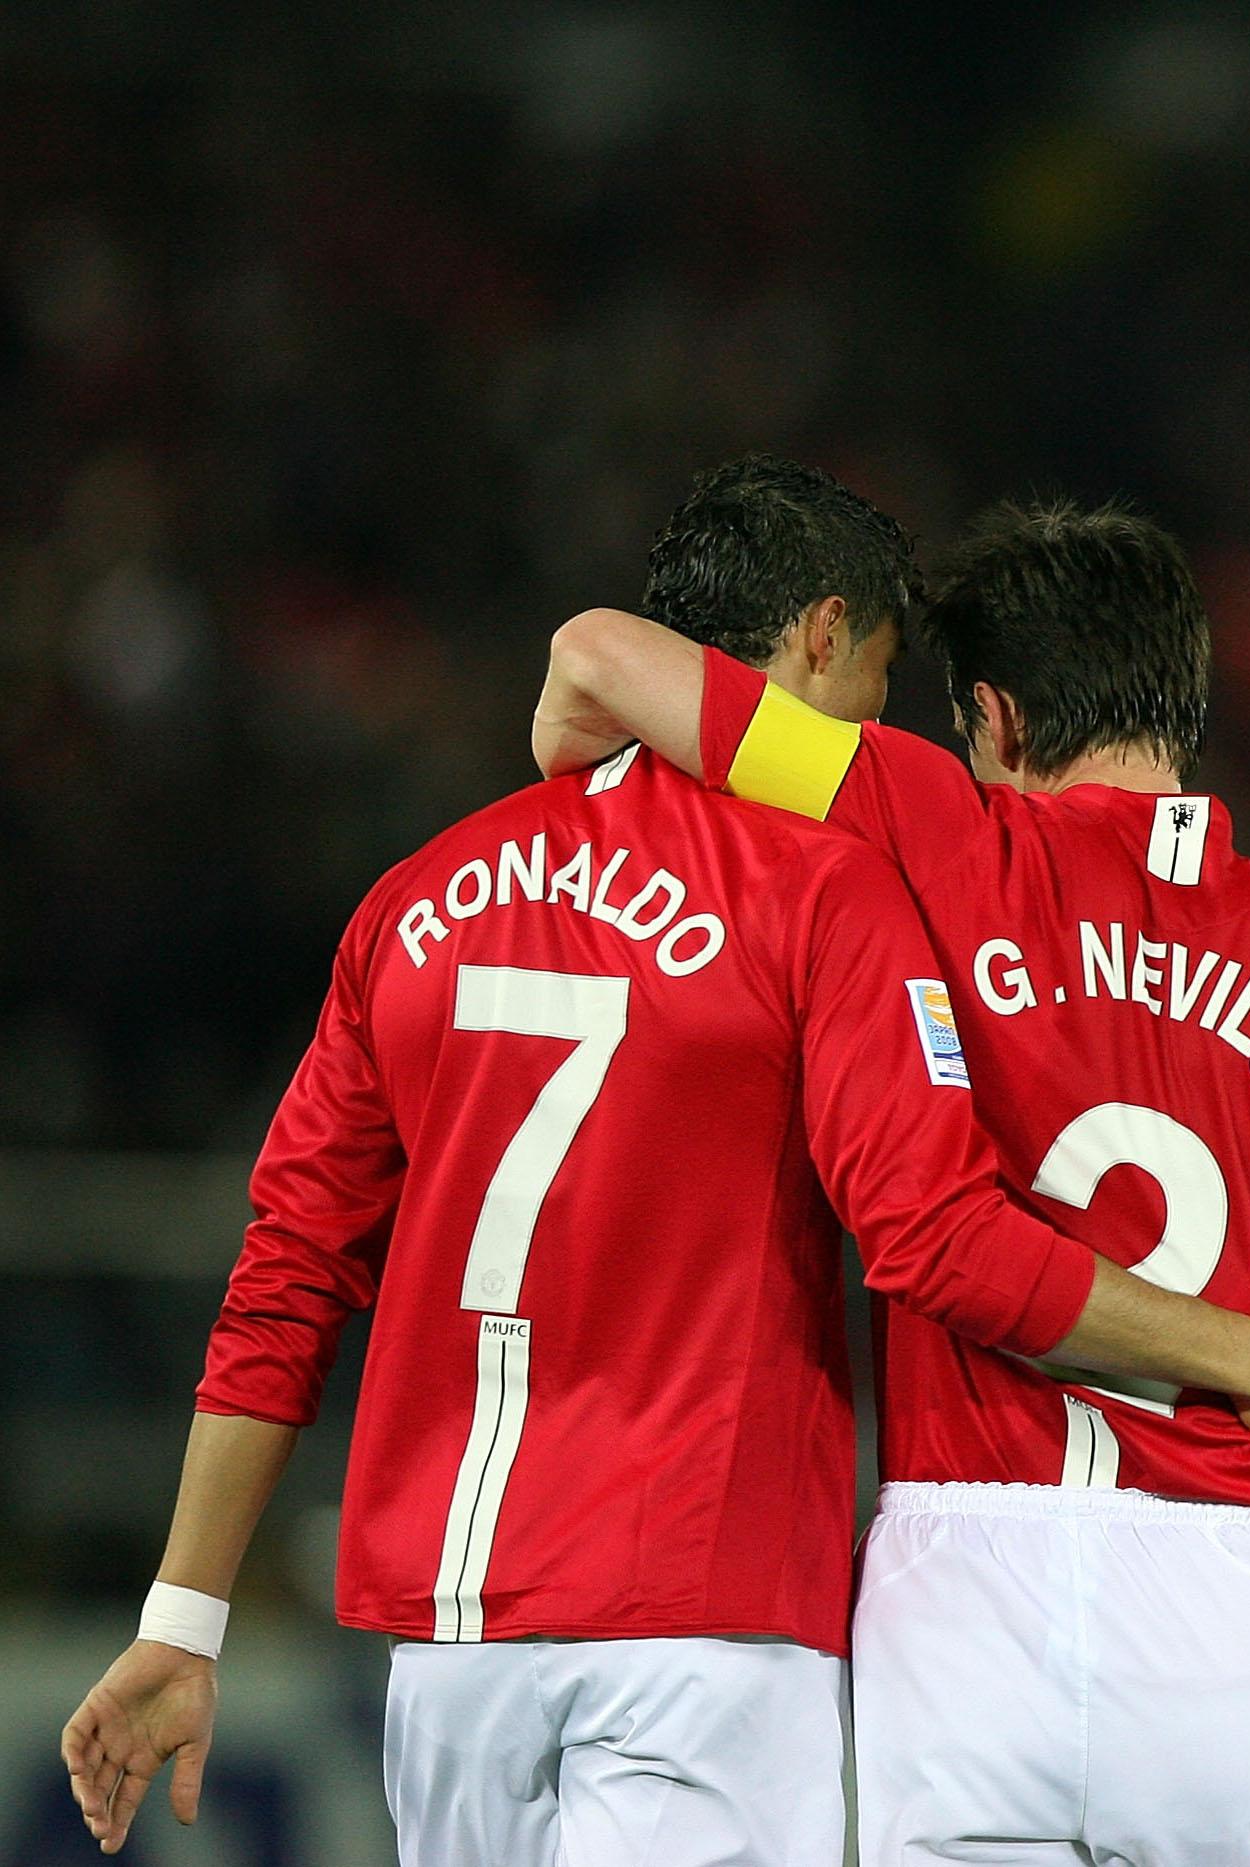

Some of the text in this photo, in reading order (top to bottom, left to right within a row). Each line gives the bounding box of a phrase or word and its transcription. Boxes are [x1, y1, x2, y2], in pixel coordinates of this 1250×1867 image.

[397, 832, 726, 977] RONALDO
[453, 964, 631, 1315] 7
[484, 1321, 527, 1338] MUFC
[1031, 1102, 1229, 1419] 2
